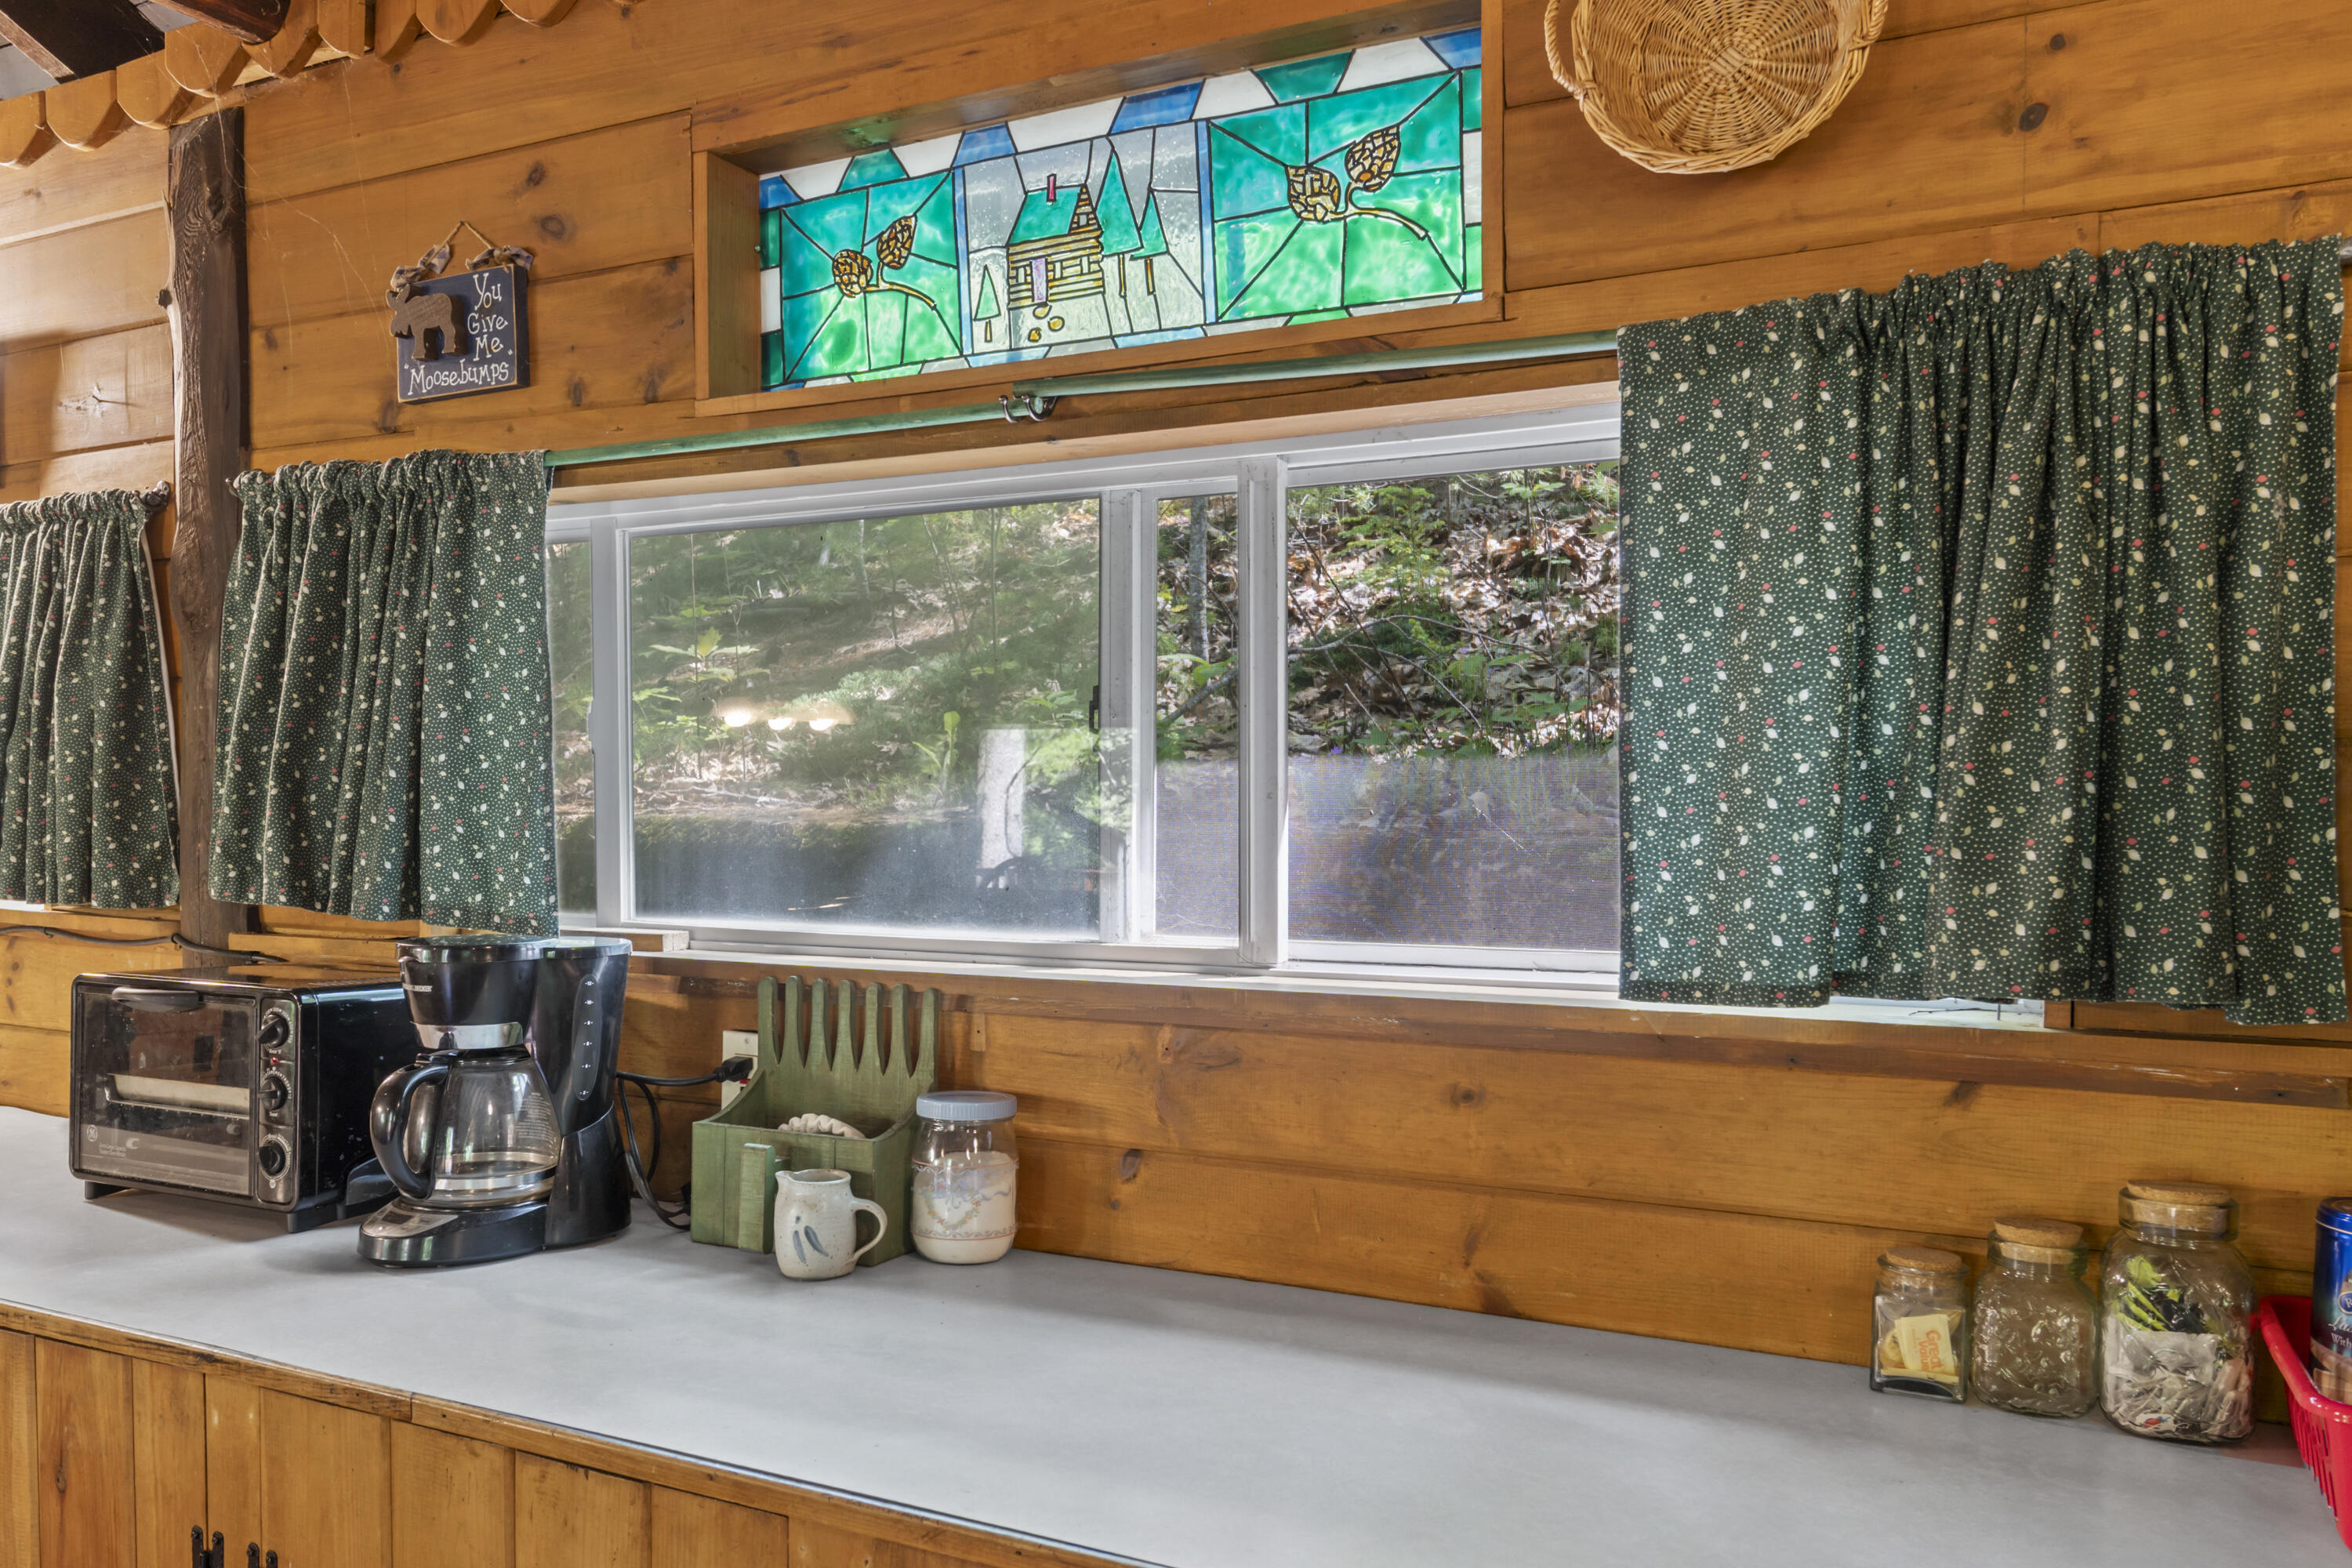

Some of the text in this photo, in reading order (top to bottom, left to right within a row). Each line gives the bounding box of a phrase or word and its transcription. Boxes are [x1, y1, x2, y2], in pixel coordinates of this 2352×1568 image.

[474, 273, 503, 310] You
[467, 312, 509, 335] Give
[473, 335, 504, 361] Me
[1926, 1330, 1944, 1370] Great
[2331, 1332, 2352, 1349] With
